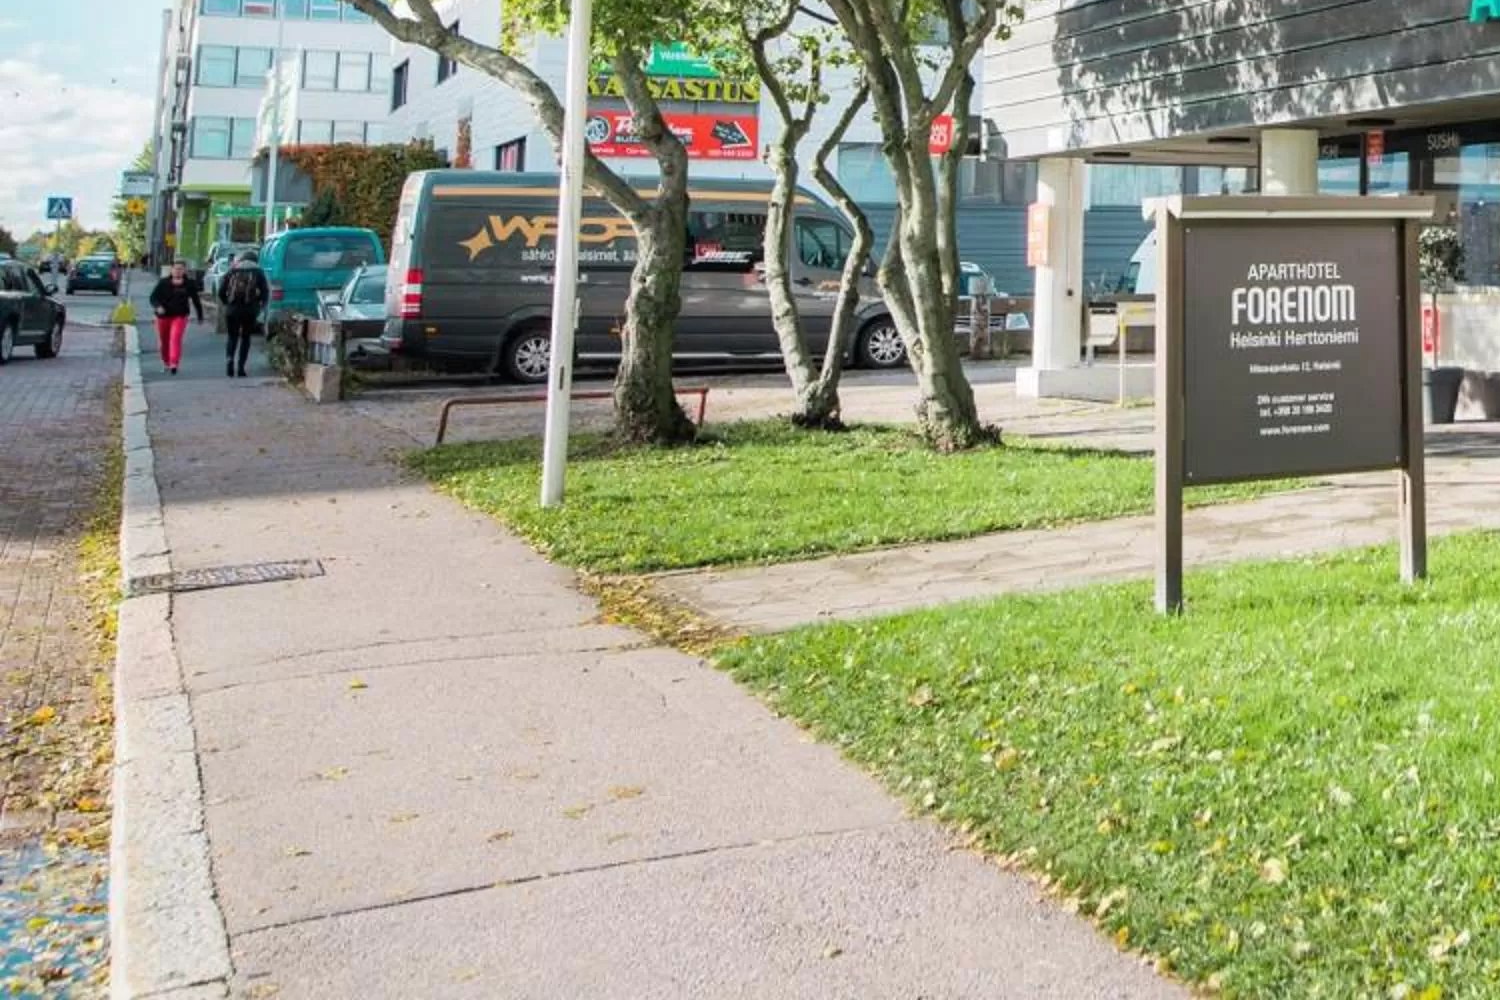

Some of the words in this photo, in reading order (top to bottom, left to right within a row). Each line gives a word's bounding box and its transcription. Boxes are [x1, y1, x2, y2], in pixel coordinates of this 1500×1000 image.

[1247, 263, 1341, 280] APARTHOTEL
[1231, 285, 1357, 326] FORENOM
[1230, 330, 1281, 348] Helsinki
[1285, 328, 1360, 346] Herttoniemi
